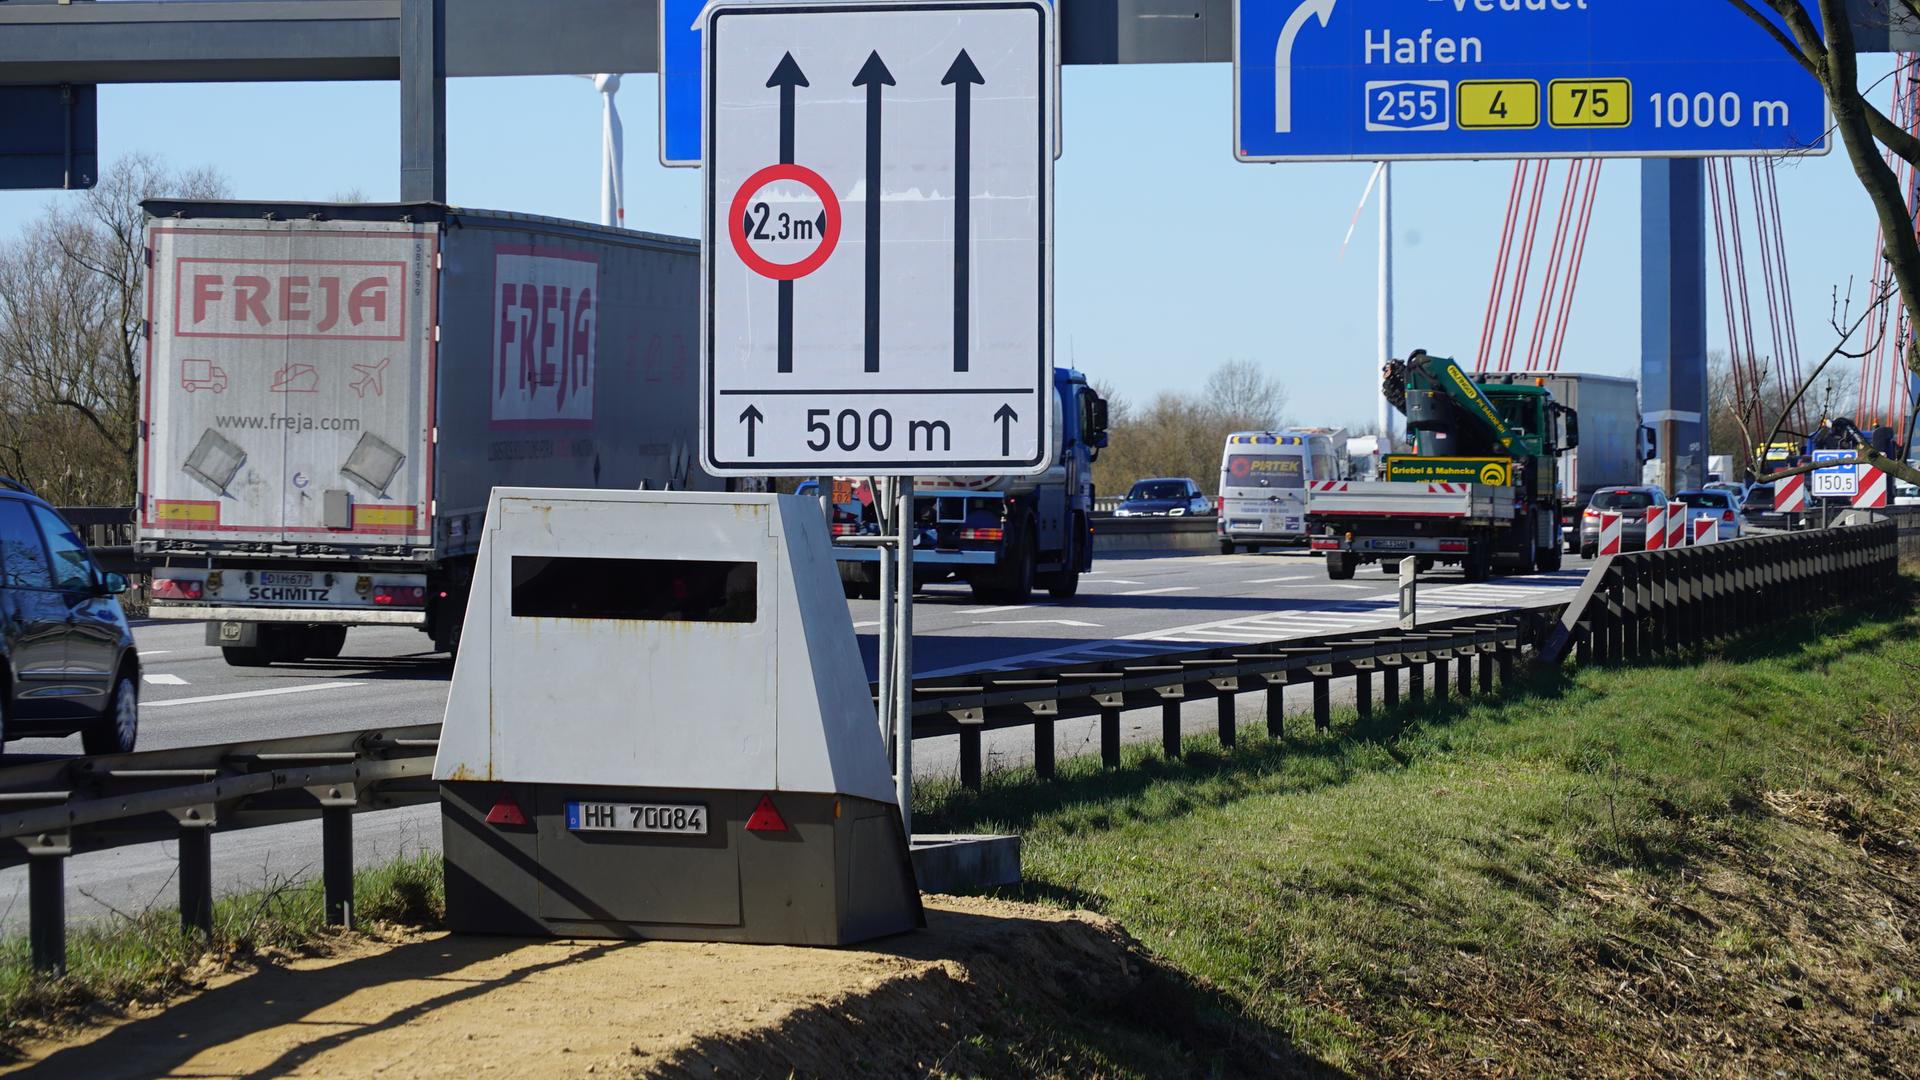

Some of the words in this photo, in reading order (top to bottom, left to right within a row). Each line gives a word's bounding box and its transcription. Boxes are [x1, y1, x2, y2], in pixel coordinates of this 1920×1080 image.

[1364, 29, 1482, 64] Hafen
[1377, 90, 1438, 121] 255
[1489, 90, 1508, 119] 4
[1570, 89, 1609, 118] 75
[1649, 91, 1741, 128] 1000
[1753, 99, 1789, 127] m
[753, 202, 813, 242] 2,3m
[193, 274, 389, 333] FREJA
[499, 283, 592, 413] FREJA
[216, 413, 360, 434] www.freja.com
[806, 408, 893, 452] 500
[908, 419, 951, 451] m
[1250, 461, 1299, 472] PIRTEK
[1392, 467, 1425, 475] Griebel
[1436, 467, 1476, 475] Mahncke
[249, 587, 329, 601] SCHMITZ
[585, 805, 615, 827] HH
[630, 806, 701, 830] 70084
